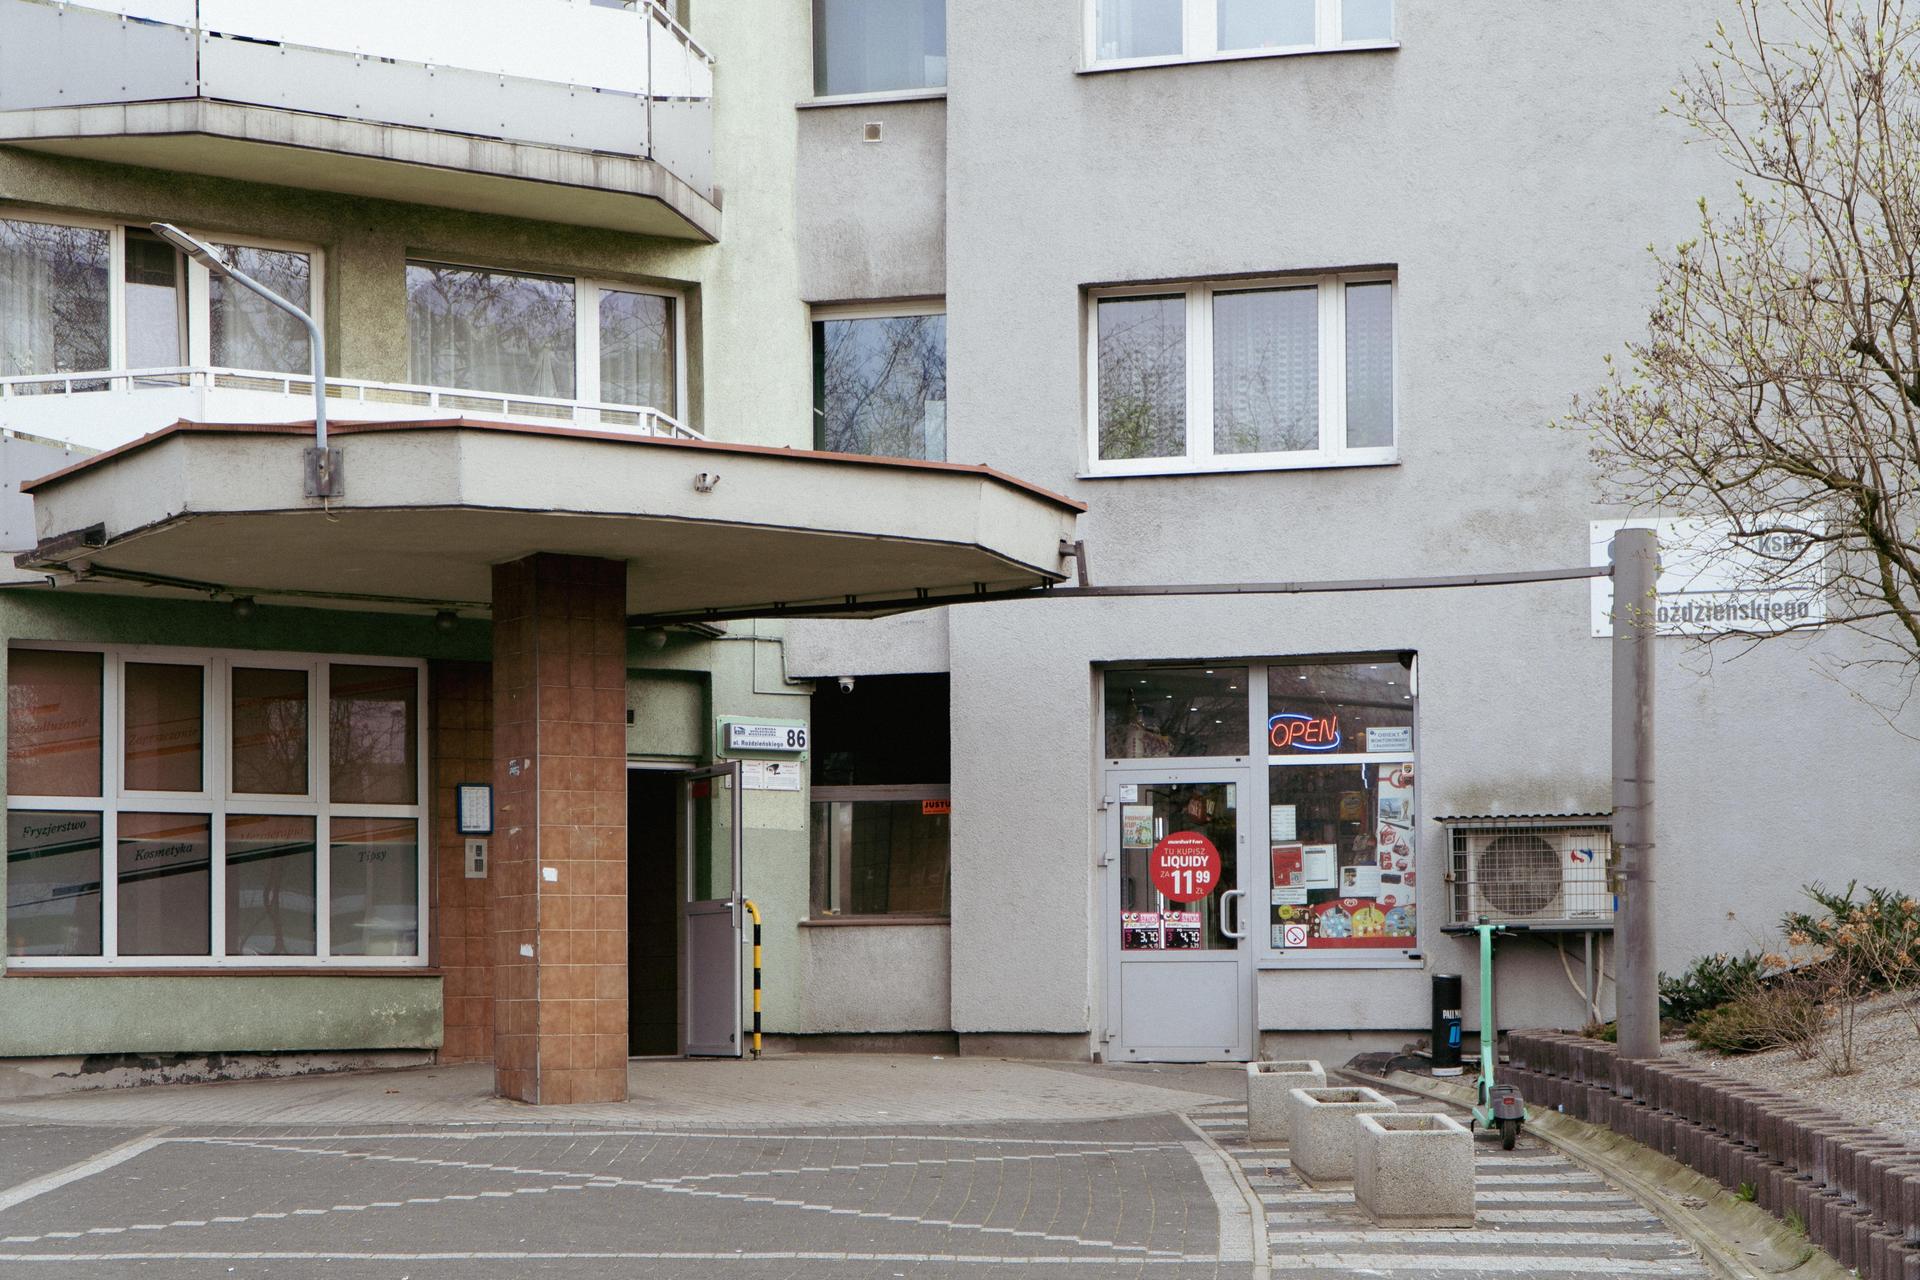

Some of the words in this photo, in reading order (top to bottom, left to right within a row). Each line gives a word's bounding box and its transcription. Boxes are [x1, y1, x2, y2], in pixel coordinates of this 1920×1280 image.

[787, 729, 806, 748] 86
[1270, 715, 1337, 747] OPEN
[23, 821, 87, 838] Fryzjerstwo
[135, 843, 193, 861] Kosmetyka
[358, 849, 387, 862] Tipsy
[1164, 847, 1174, 855] TU
[1177, 847, 1206, 855] KUPISZ
[1161, 855, 1209, 869] LIQUIDY
[1160, 870, 1170, 879] ZA
[1171, 870, 1193, 895] 11
[1195, 870, 1211, 884] 99
